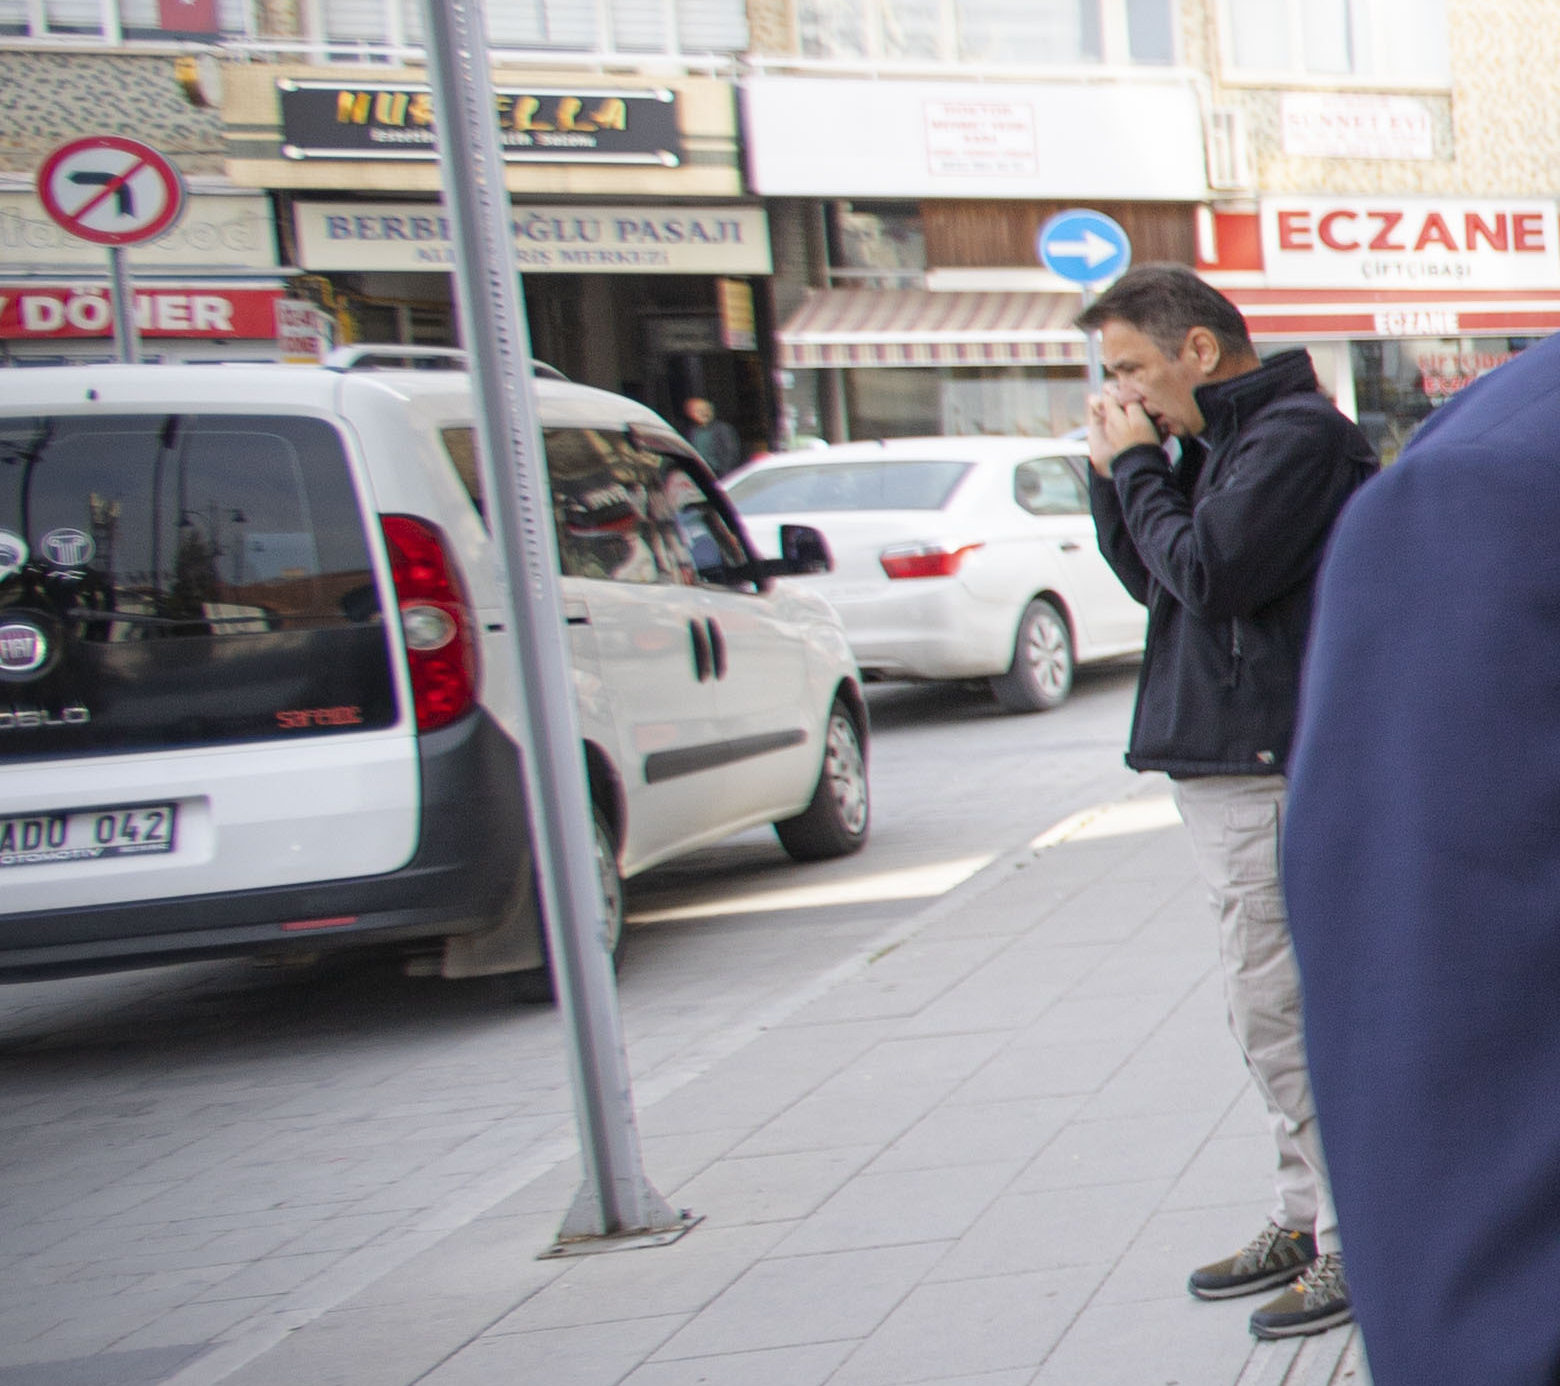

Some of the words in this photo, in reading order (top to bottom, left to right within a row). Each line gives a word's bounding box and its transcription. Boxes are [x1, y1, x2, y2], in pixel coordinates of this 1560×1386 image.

[616, 218, 745, 246] PASAJI
[1277, 210, 1546, 252] ECZANE
[1375, 311, 1459, 335] ECZANE
[95, 811, 167, 844] 042
